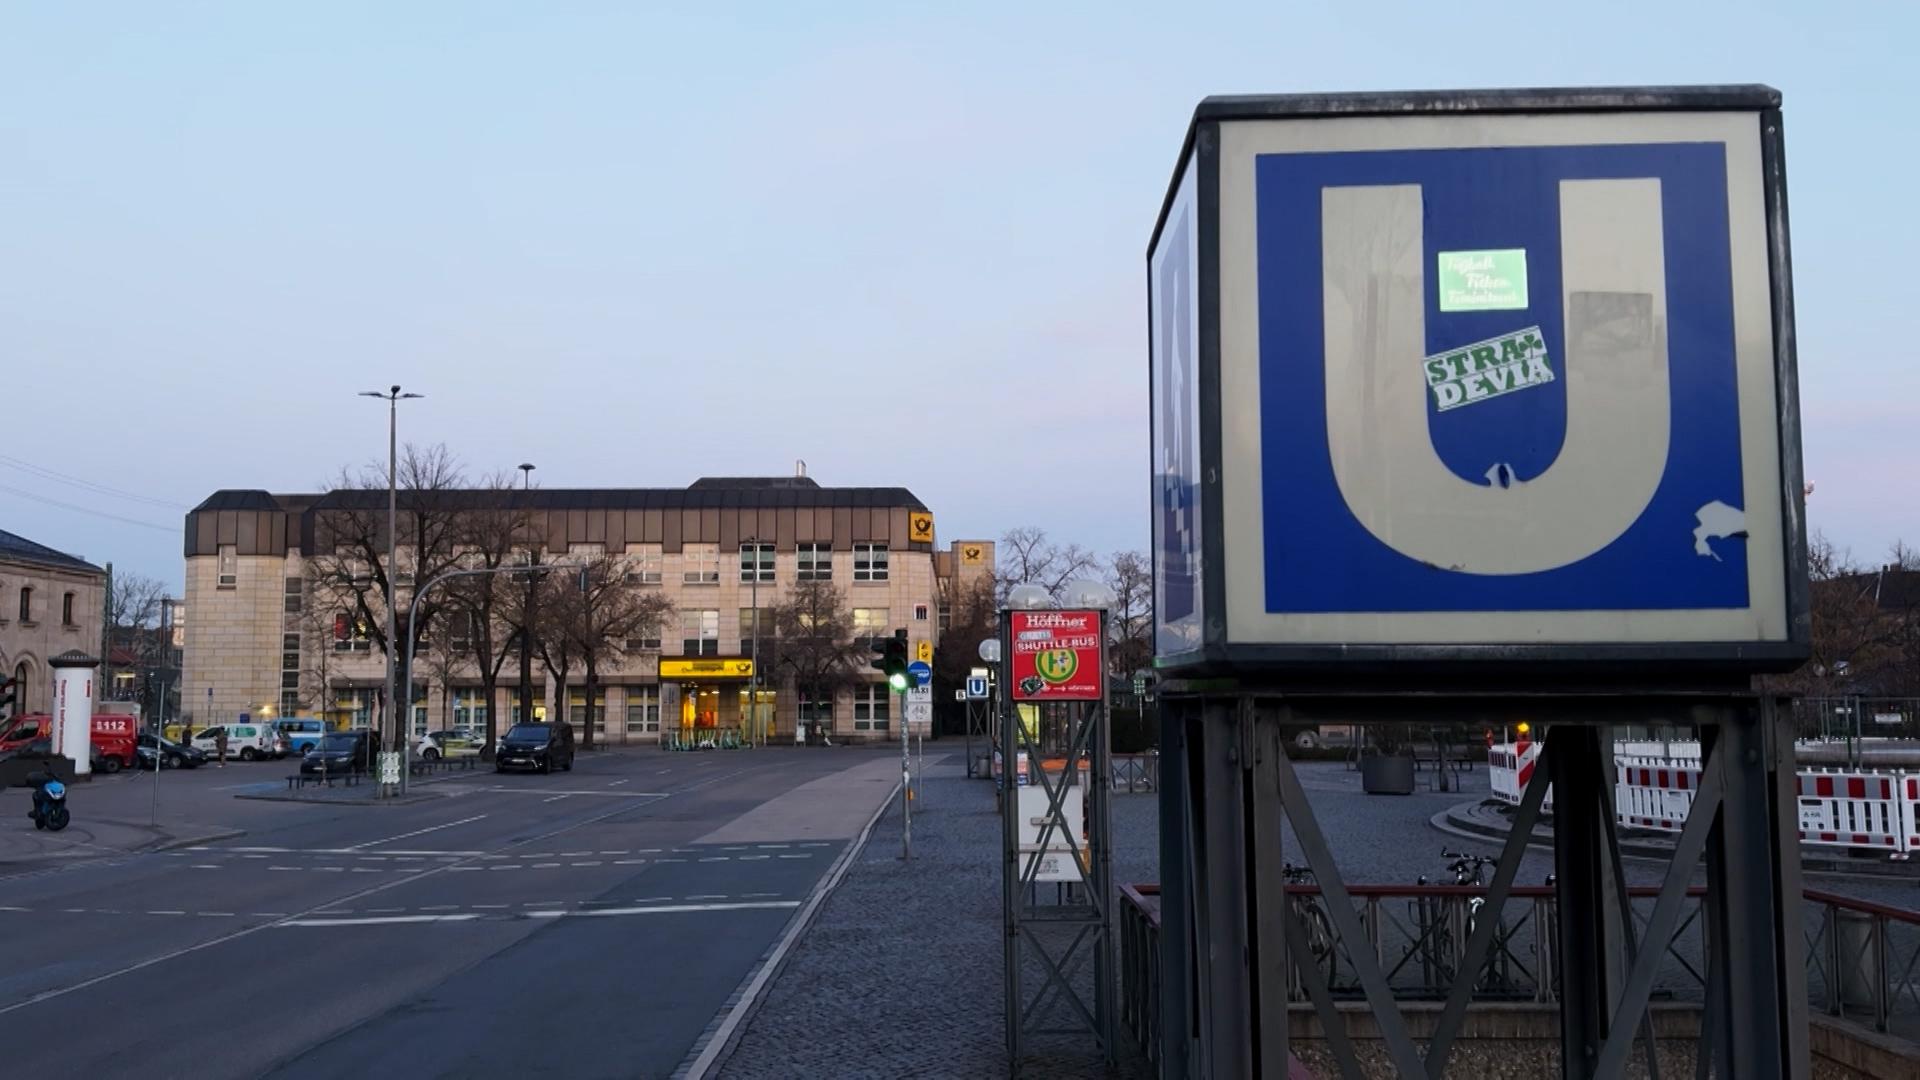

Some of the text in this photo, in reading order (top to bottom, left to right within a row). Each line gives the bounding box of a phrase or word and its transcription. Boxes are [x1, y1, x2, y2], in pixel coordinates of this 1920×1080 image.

[1427, 339, 1525, 384] STRA
[1321, 176, 1671, 577] U
[1433, 357, 1554, 409] DEVIA
[1026, 614, 1088, 628] Höffner
[1017, 636, 1096, 651] SHUTTLE-BUS
[971, 680, 984, 695] U
[104, 721, 126, 731] 112
